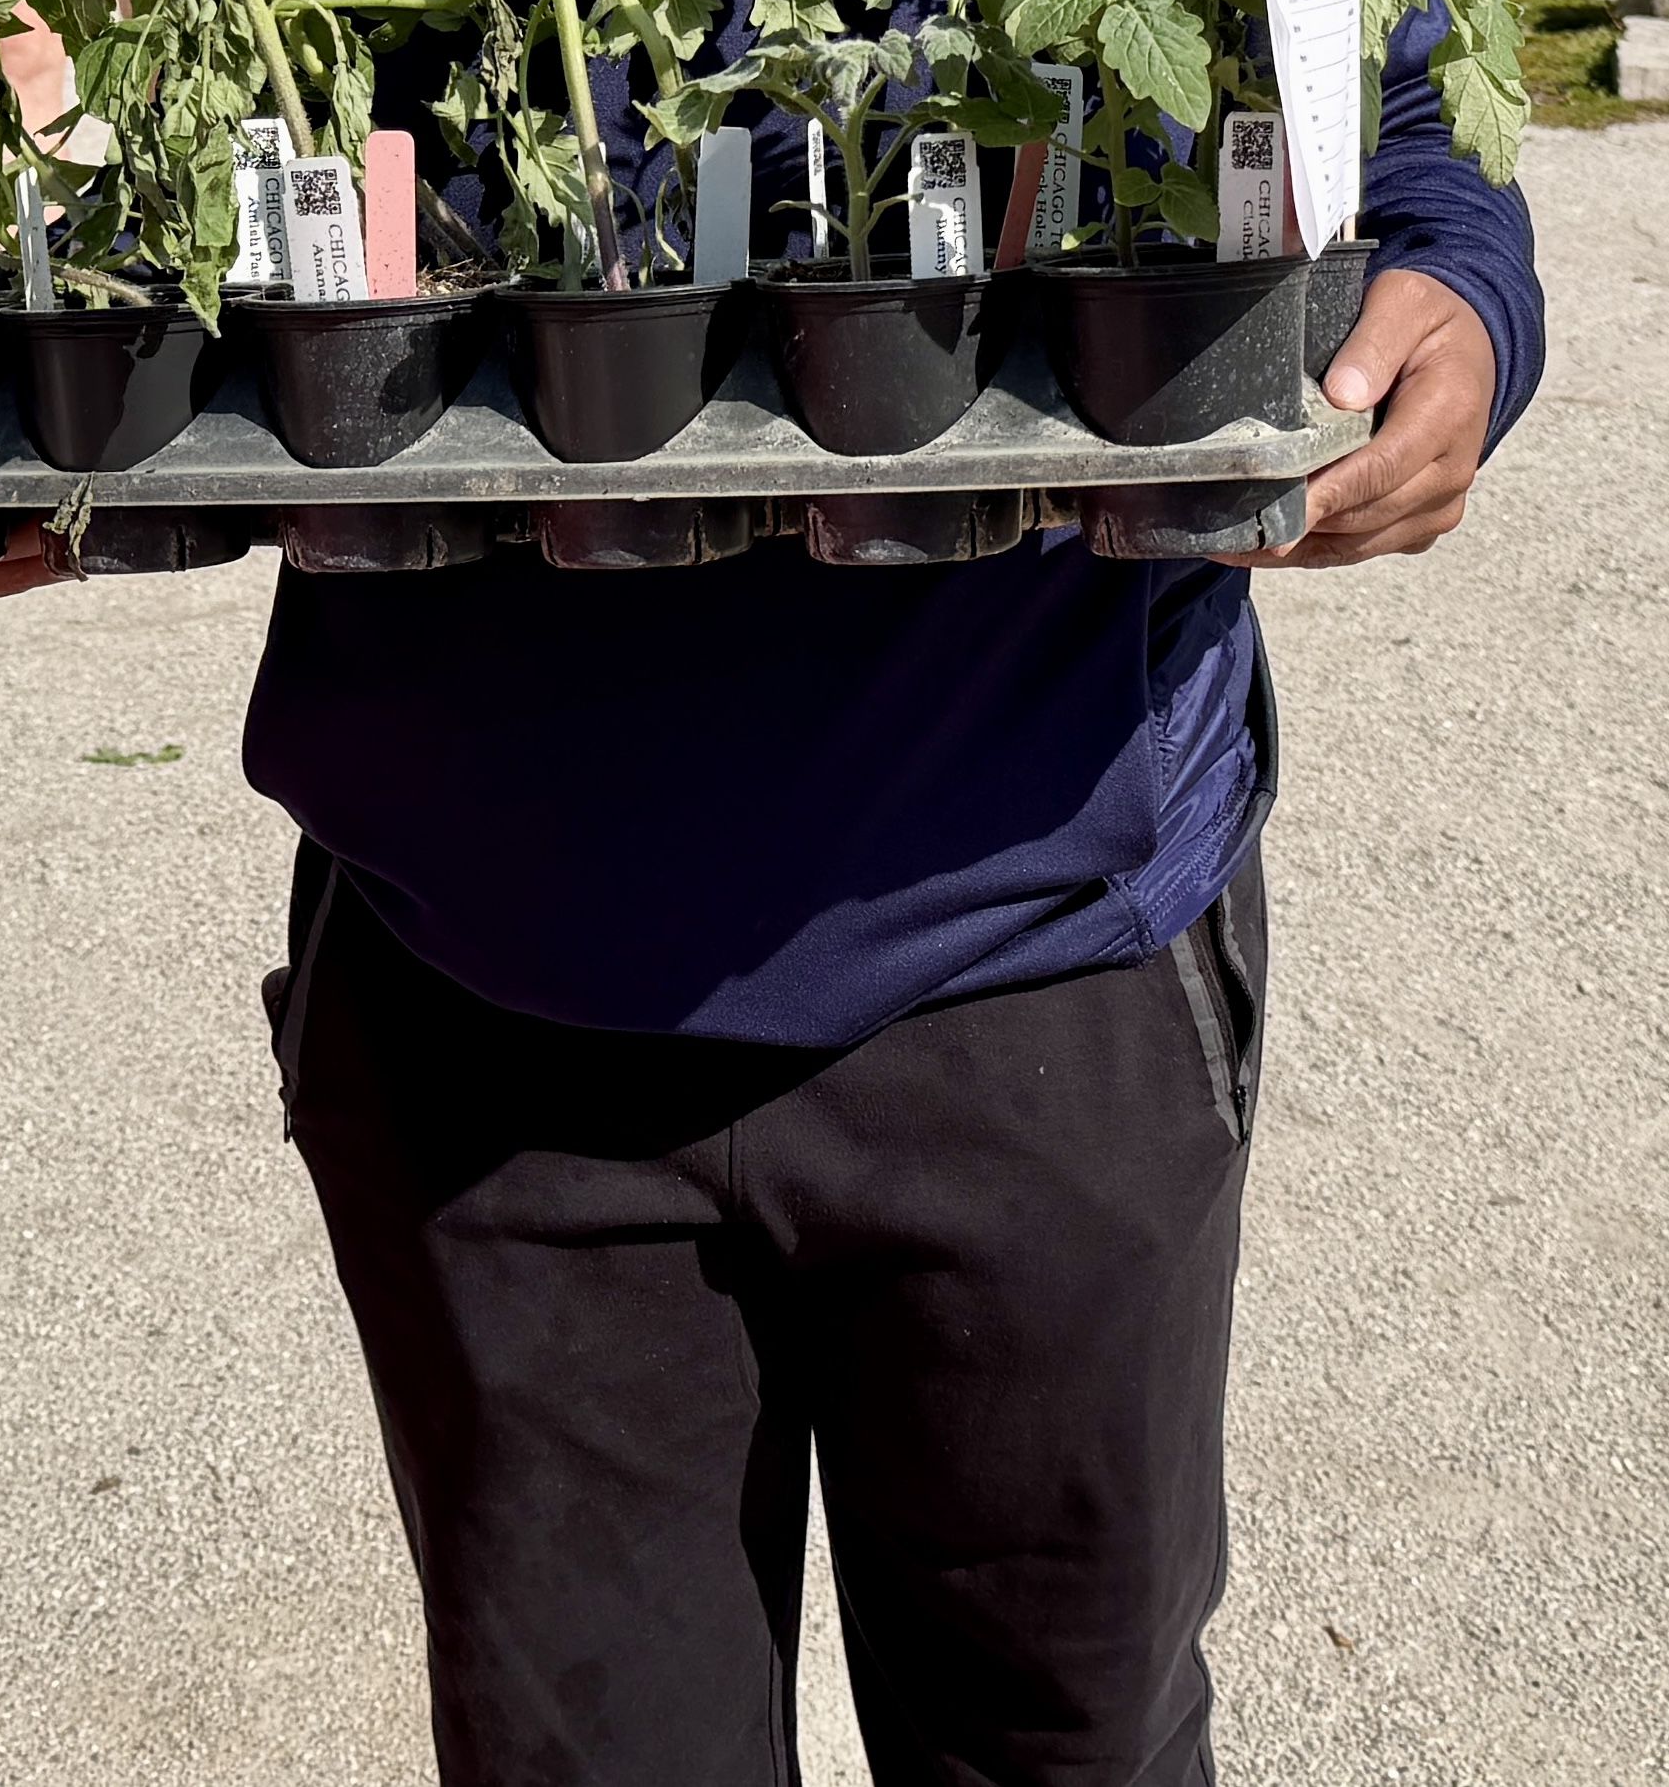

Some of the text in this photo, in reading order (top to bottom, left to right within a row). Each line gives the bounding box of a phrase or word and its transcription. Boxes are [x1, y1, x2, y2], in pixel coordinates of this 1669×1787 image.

[1051, 132, 1067, 224] CHICAGO
[247, 196, 262, 248] Amish
[264, 177, 283, 265] CHICAGO
[934, 217, 948, 275] Bunny
[1034, 198, 1047, 239] Hole
[328, 223, 351, 301] CHICAG
